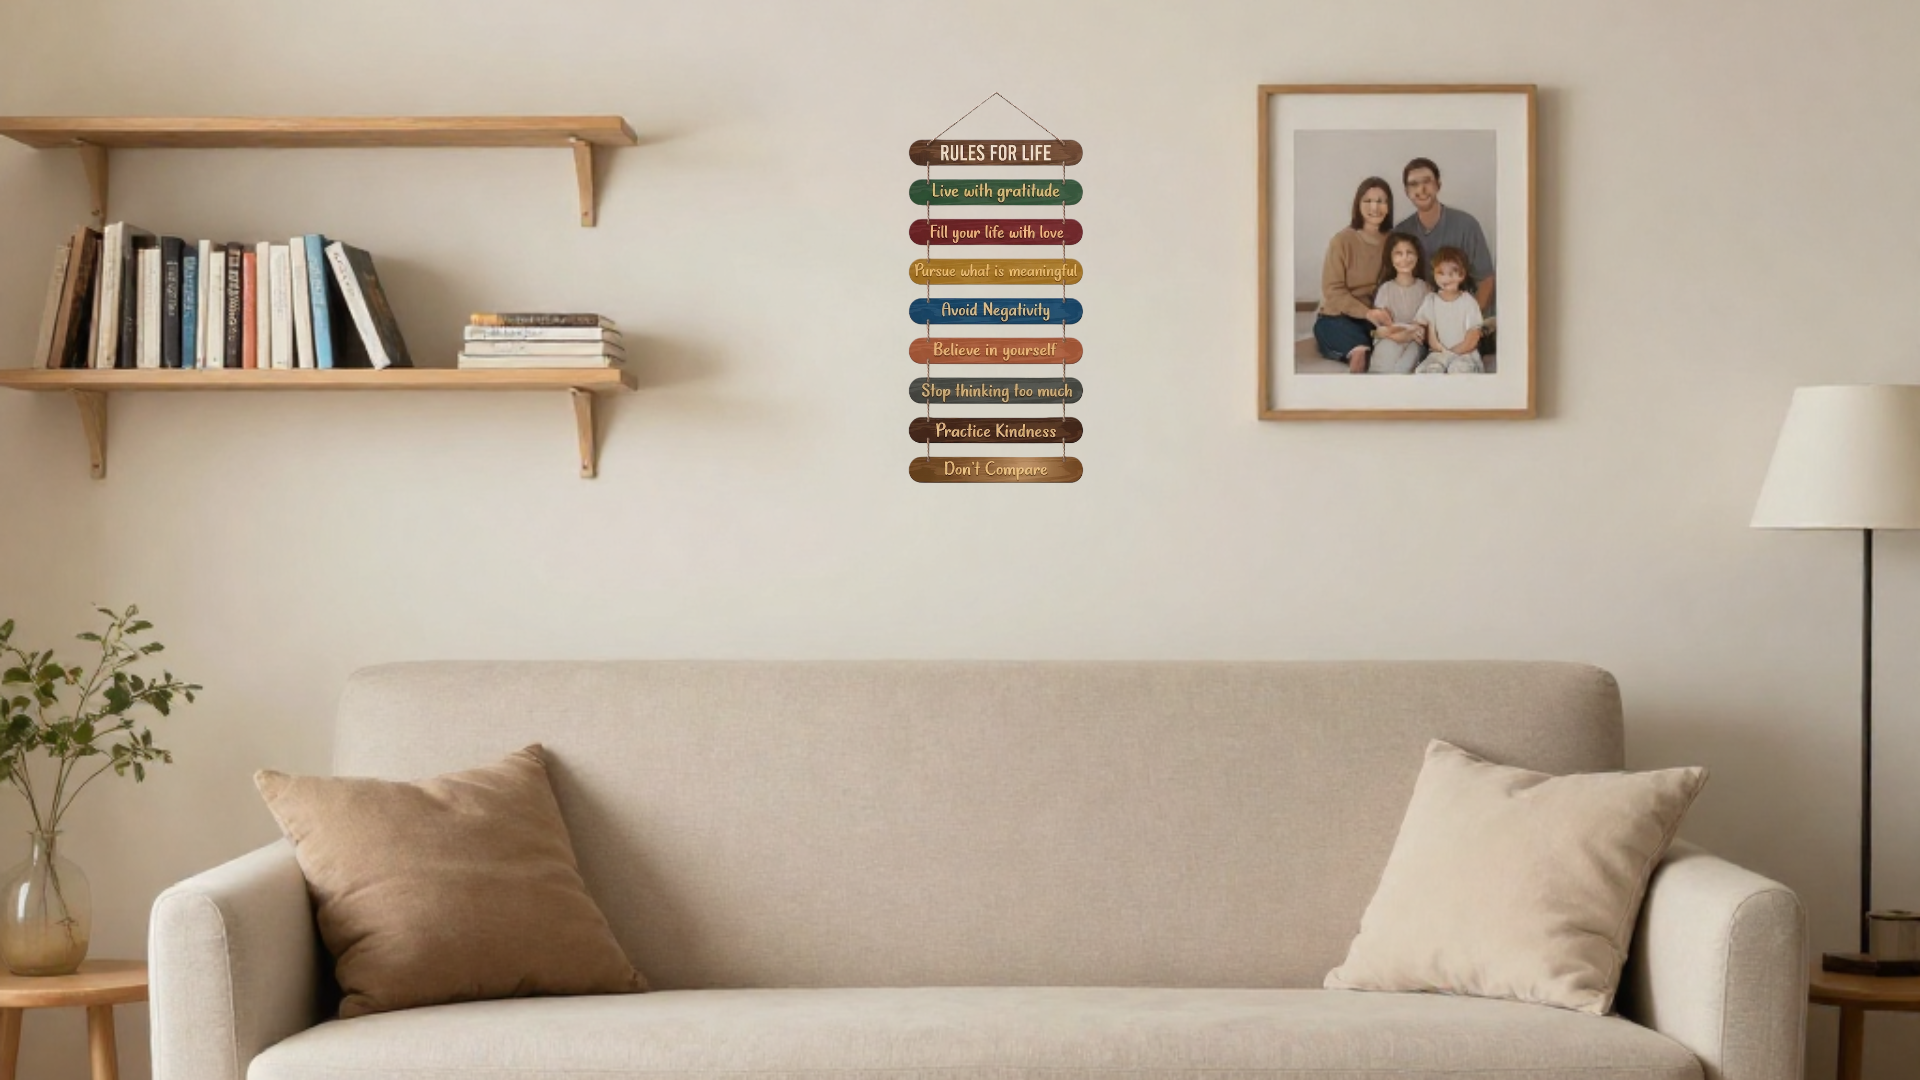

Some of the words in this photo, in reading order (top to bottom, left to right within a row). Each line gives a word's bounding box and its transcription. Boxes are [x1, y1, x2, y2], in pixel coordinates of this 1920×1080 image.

[940, 144, 985, 161] RULES
[990, 144, 1017, 161] FOR
[1022, 144, 1052, 161] LIFE
[932, 183, 960, 198] Live
[964, 182, 993, 198] with
[997, 183, 1061, 203] gratitude
[930, 224, 948, 240] Fill
[952, 228, 980, 243] your
[984, 224, 1005, 240] life
[1009, 223, 1036, 240] with
[1039, 224, 1064, 240] love
[914, 263, 957, 278] Pursue
[960, 263, 991, 278] what
[994, 264, 1005, 278] is
[1008, 263, 1078, 282] meaningful
[941, 302, 978, 317] Avoid
[983, 301, 1051, 322] Negativity
[933, 342, 981, 357] Believe
[985, 344, 998, 357] in
[1002, 342, 1057, 361] yourself
[921, 382, 952, 402] Stop
[954, 383, 1010, 403] thinking
[1013, 383, 1034, 398] too
[1037, 382, 1073, 398] much
[935, 422, 991, 439] Practice
[995, 422, 1057, 439] Kindness
[944, 460, 981, 477] Don't
[984, 461, 1048, 480] Compare
